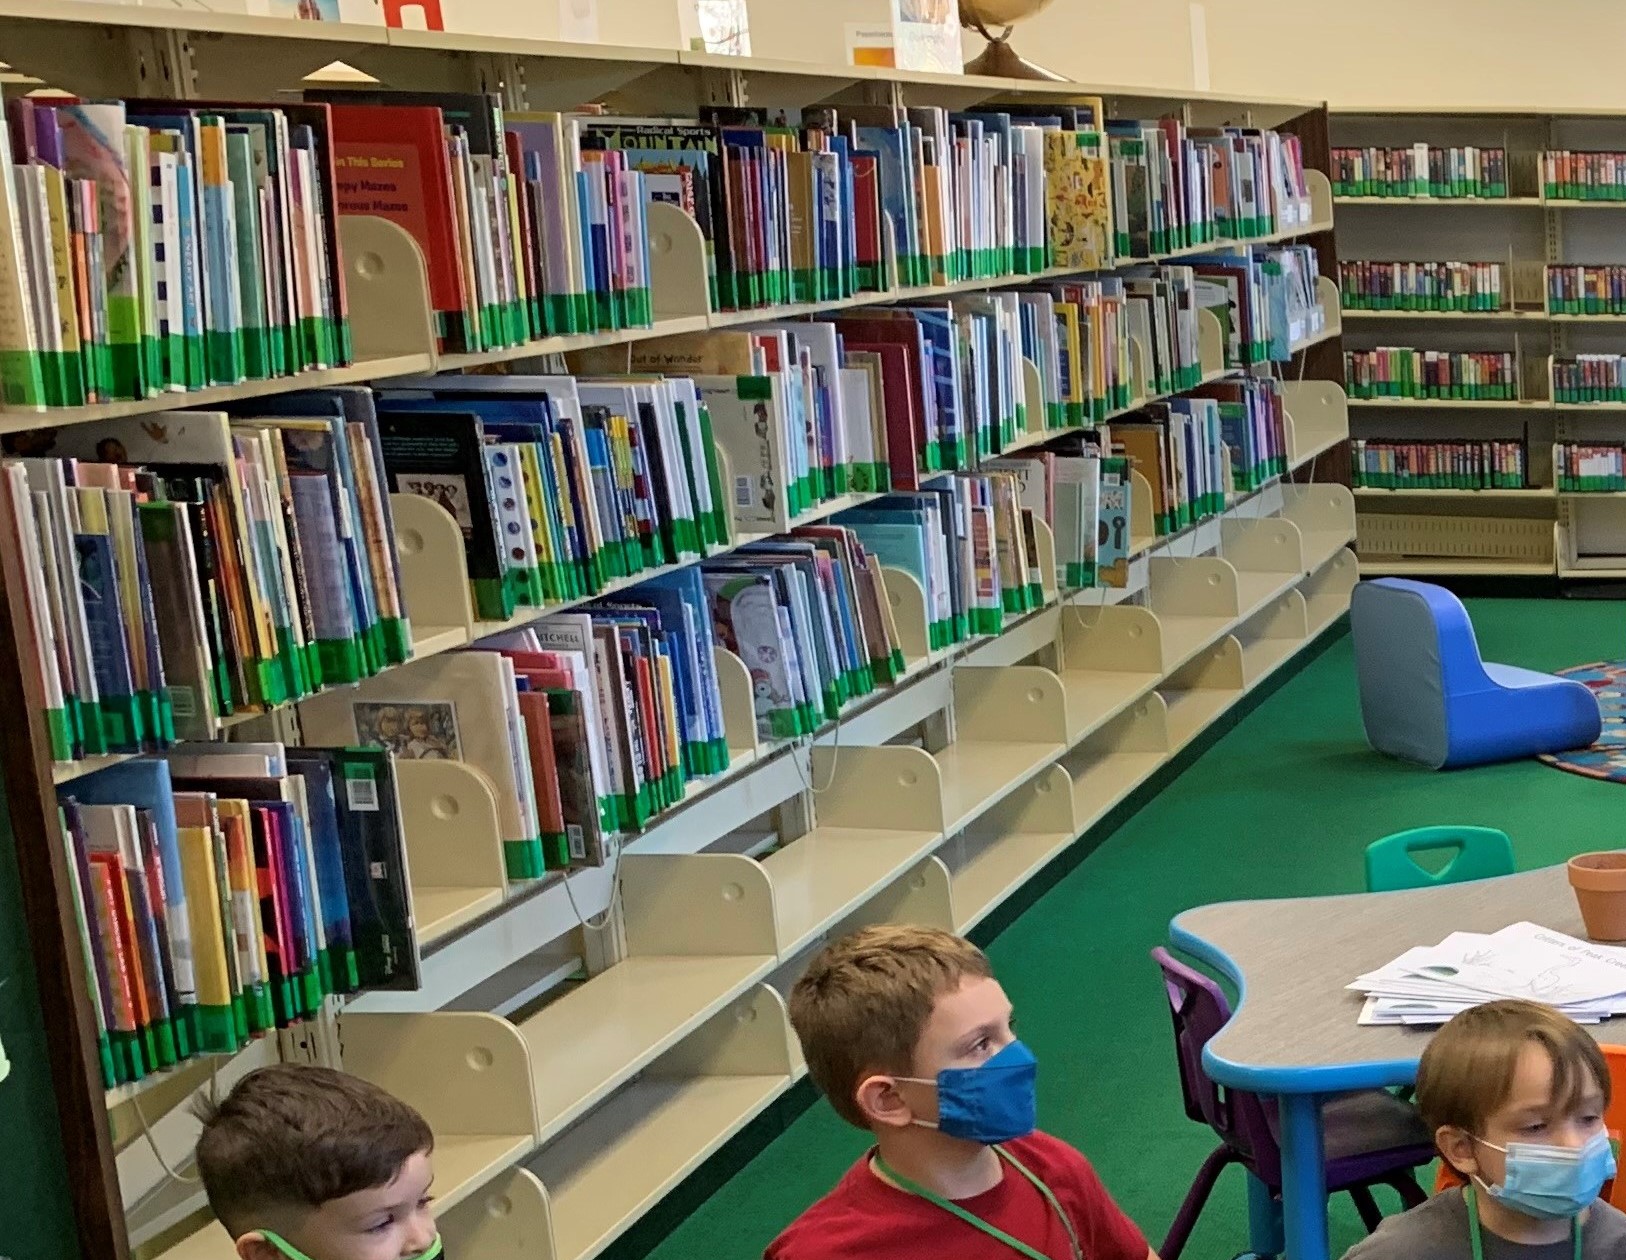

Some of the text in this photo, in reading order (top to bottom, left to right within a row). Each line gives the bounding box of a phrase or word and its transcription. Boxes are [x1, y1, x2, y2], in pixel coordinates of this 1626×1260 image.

[637, 126, 711, 136] Radical Sports
[346, 156, 369, 168] This
